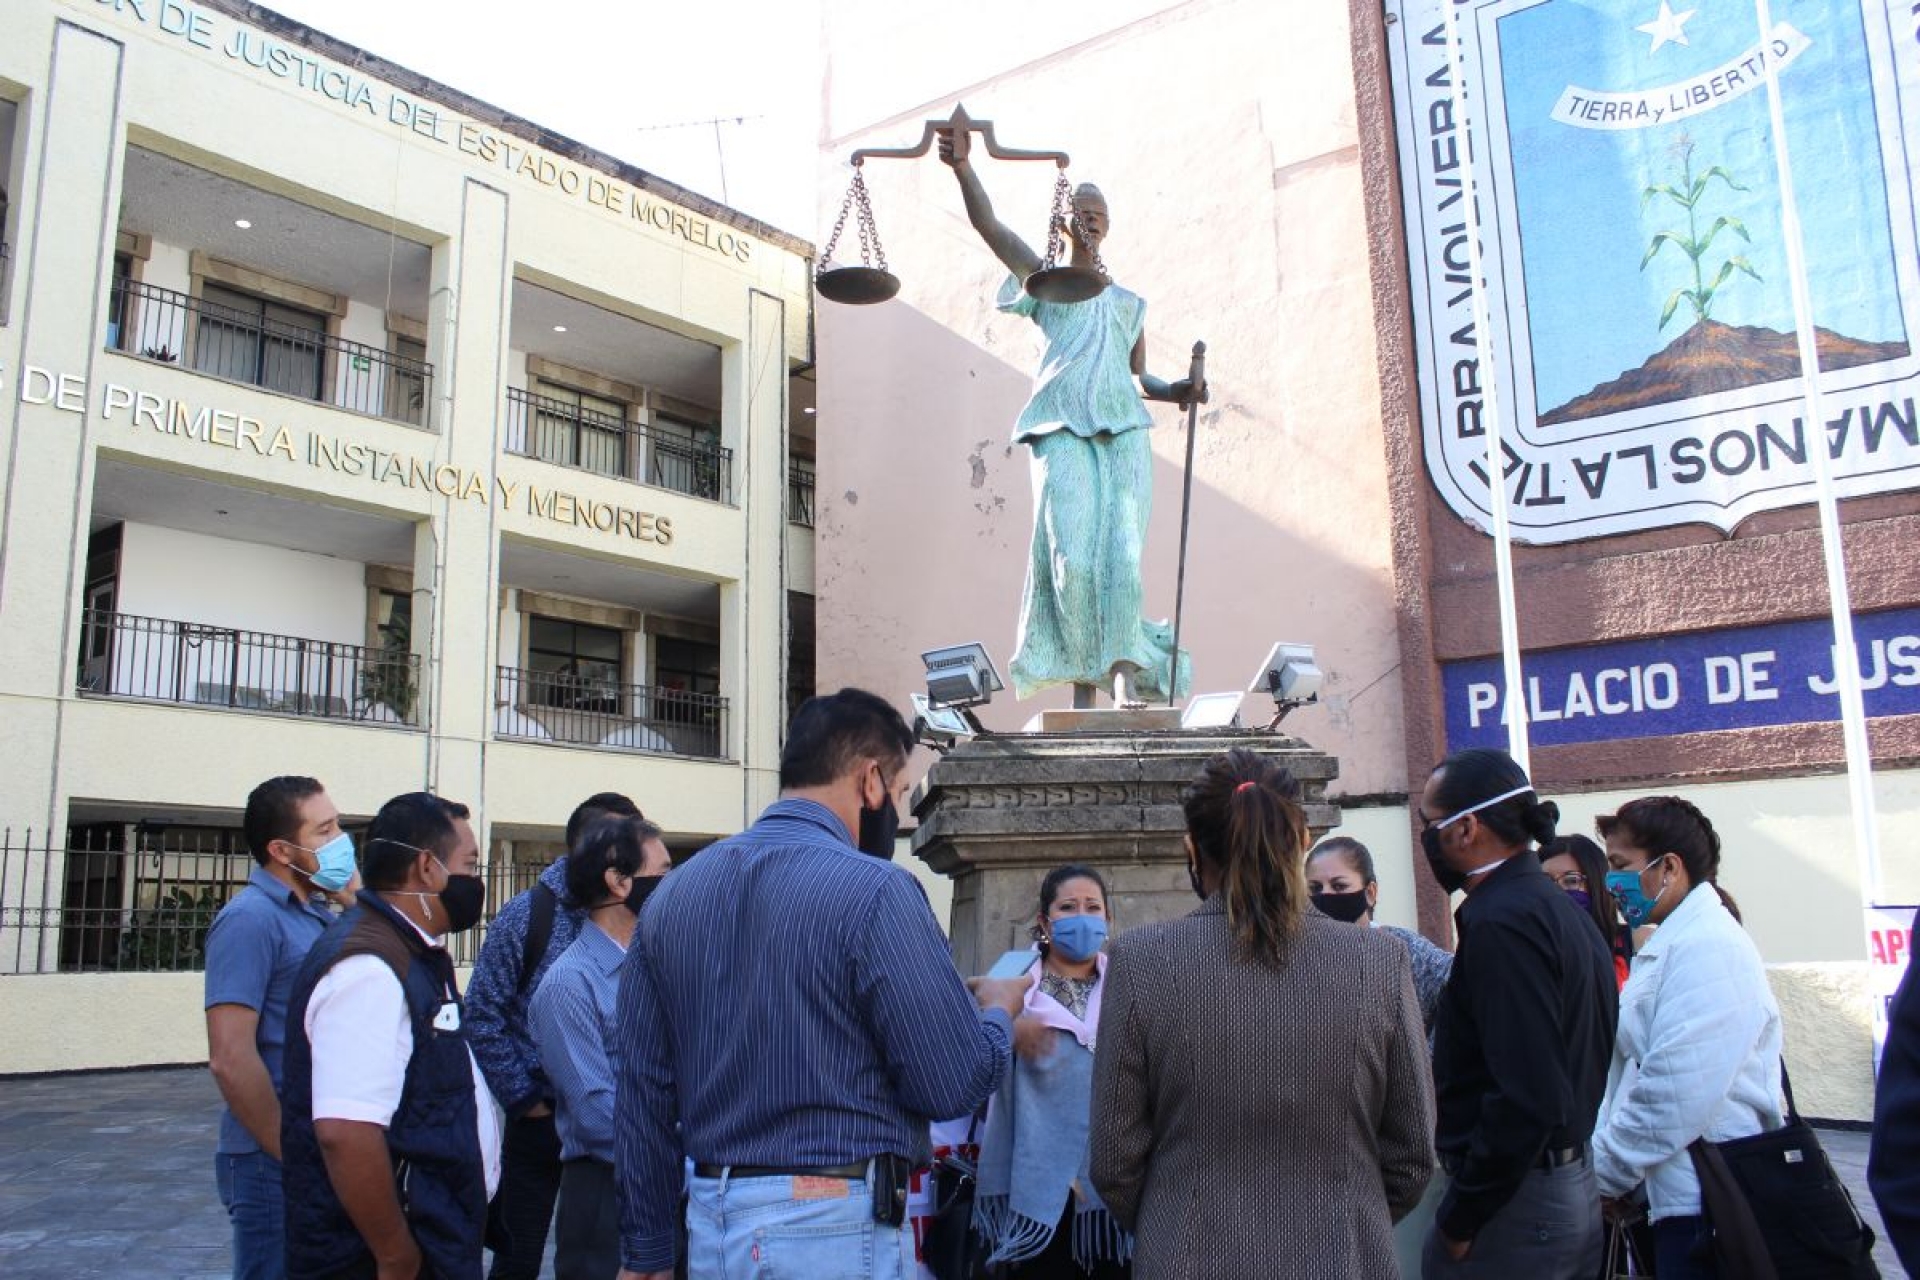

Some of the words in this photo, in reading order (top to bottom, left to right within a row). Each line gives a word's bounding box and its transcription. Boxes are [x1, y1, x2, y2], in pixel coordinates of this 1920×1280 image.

[160, 0, 214, 49] DE
[224, 31, 376, 116] JUSTICIA
[388, 94, 448, 144] DEL
[458, 122, 579, 195] ESTADO
[588, 176, 623, 214] DE
[631, 192, 751, 263] MORELOS
[1569, 96, 1649, 121] TIERRA
[21, 364, 86, 414] DE
[102, 383, 296, 461] PRIMERA
[307, 431, 488, 504] INSTANCIA
[496, 477, 518, 509] Y
[528, 485, 673, 546] MENORES
[1670, 397, 1920, 484] MANOS
[1571, 444, 1659, 500] LA
[1705, 651, 1778, 705] DE
[1871, 929, 1912, 965] AP
